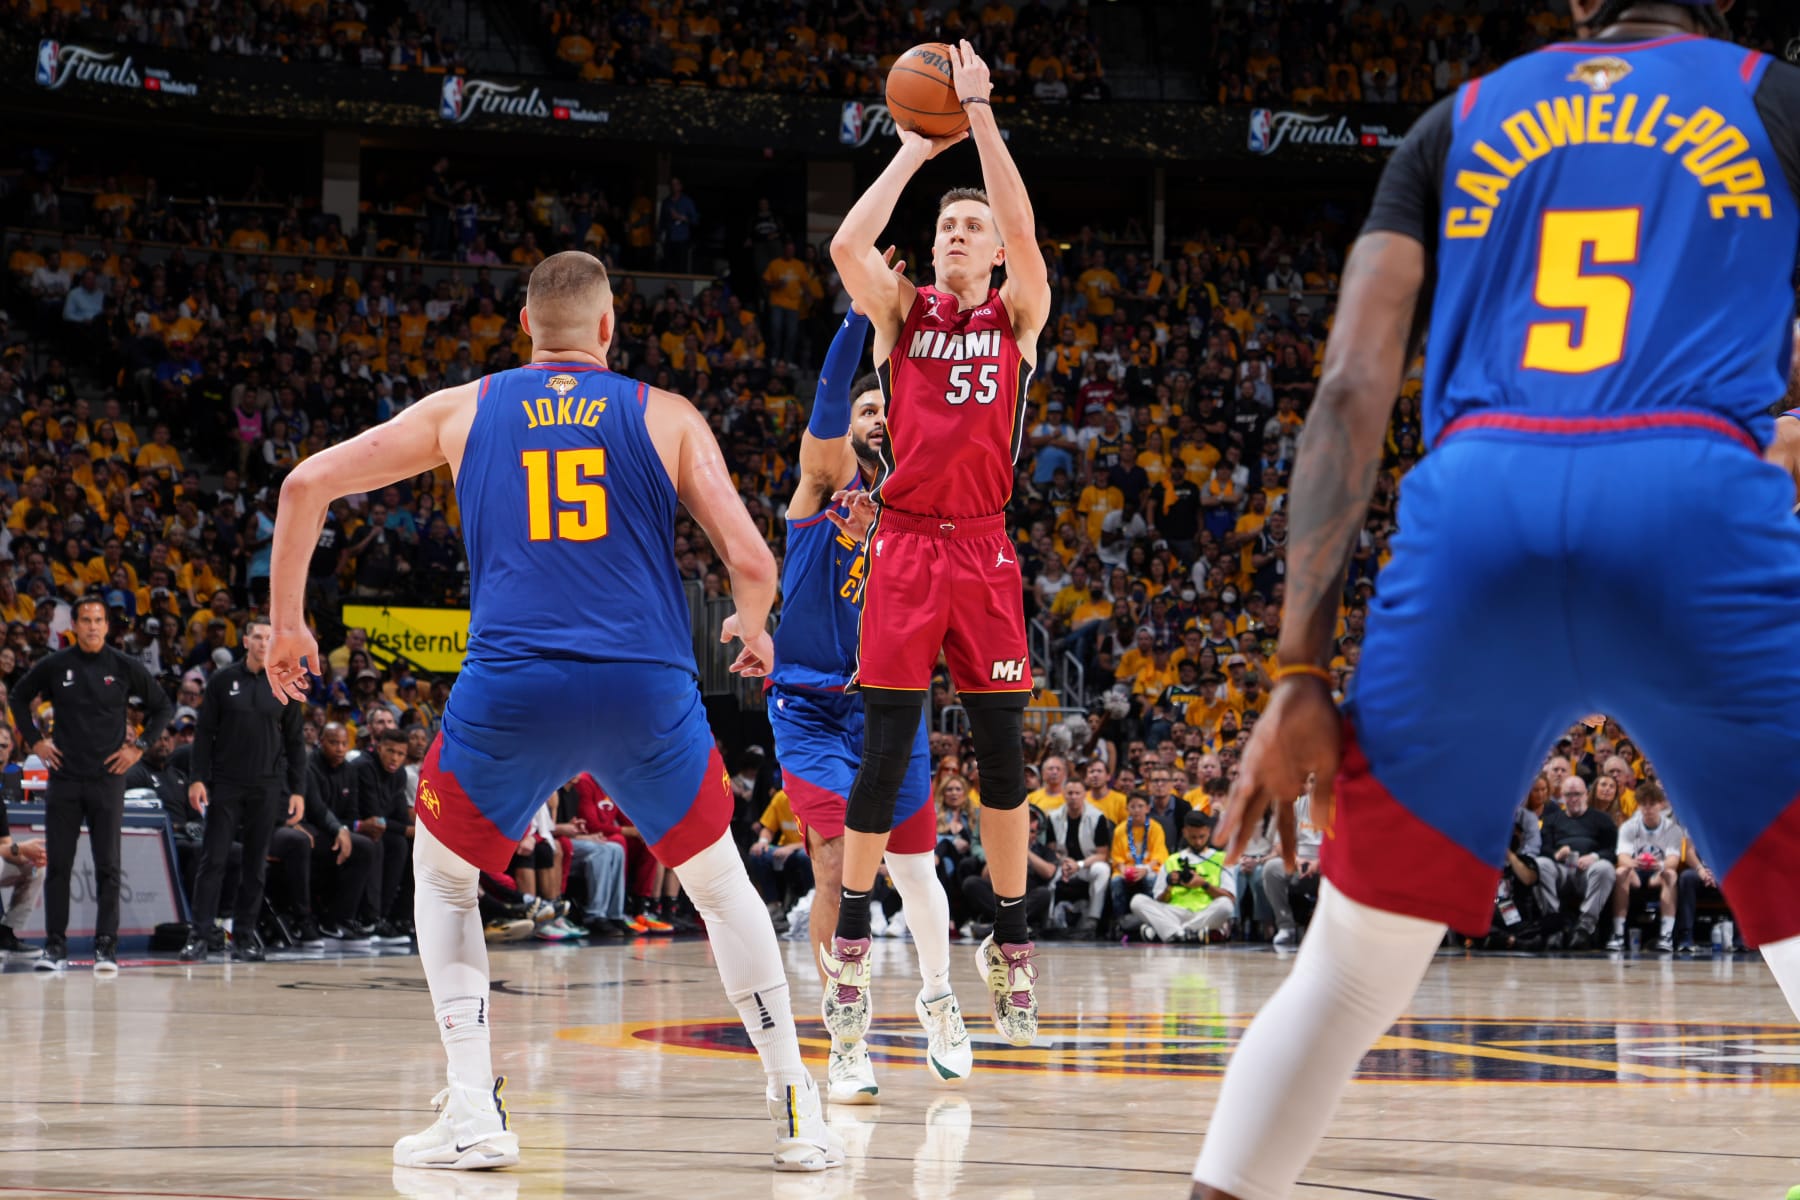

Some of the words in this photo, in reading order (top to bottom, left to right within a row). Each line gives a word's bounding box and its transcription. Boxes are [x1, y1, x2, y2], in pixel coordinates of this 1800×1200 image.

[50, 45, 141, 89] Finals
[456, 80, 549, 123] Finals
[1263, 112, 1358, 155] Finals
[1444, 93, 1773, 239] CALDWELL-POPE
[1520, 204, 1642, 375] 5
[908, 329, 1001, 361] MIAMI
[547, 376, 577, 388] Finals
[945, 364, 999, 405] 55
[521, 396, 609, 430] JOKIĆ
[521, 448, 609, 542] 15
